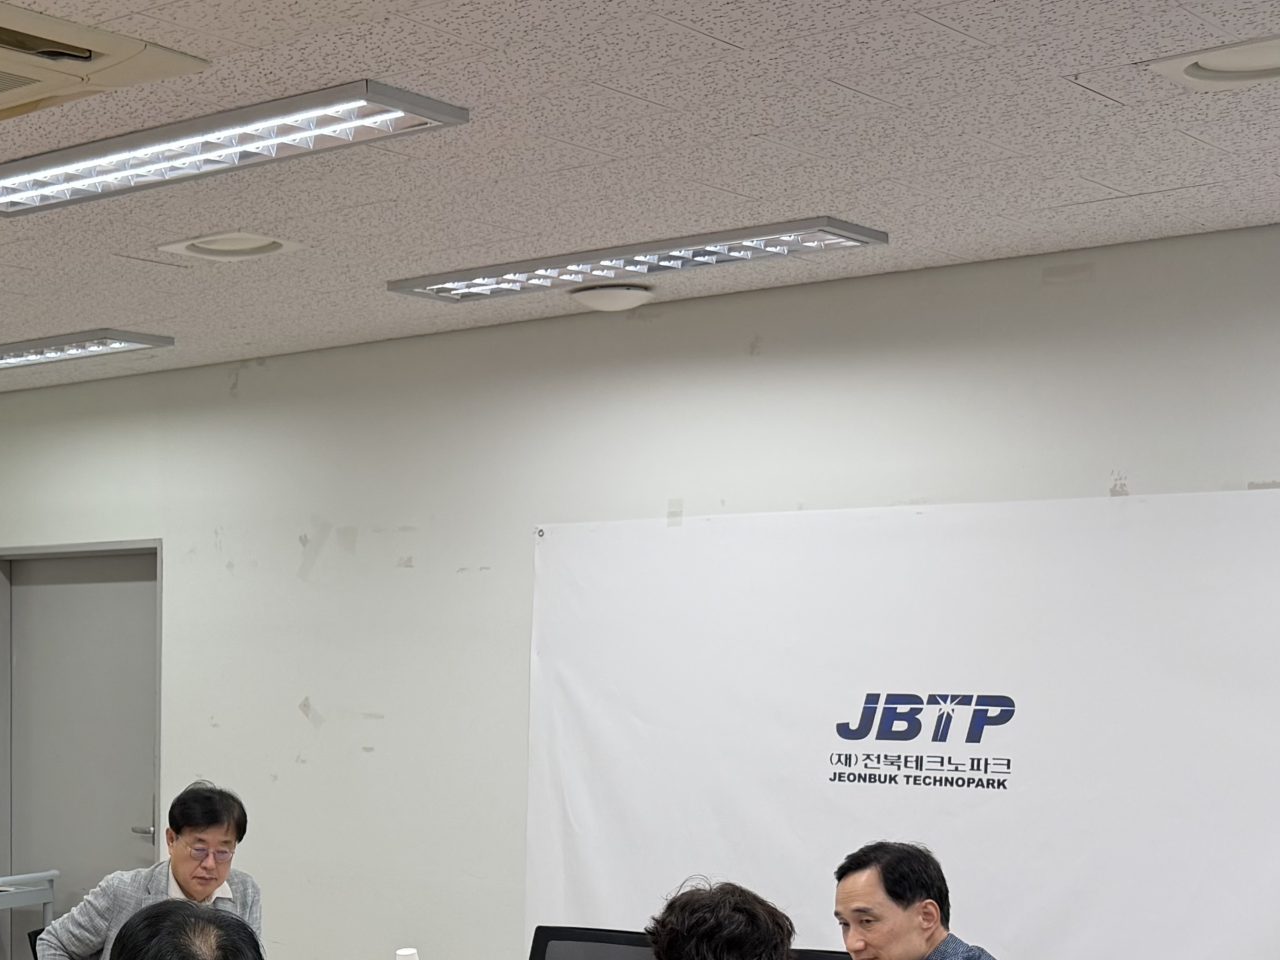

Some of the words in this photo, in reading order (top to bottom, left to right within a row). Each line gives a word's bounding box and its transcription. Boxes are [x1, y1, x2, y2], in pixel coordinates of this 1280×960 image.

[835, 693, 1016, 744] JBTP
[829, 771, 899, 785] JEONBUK
[903, 774, 1008, 790] TECHNOPARK
